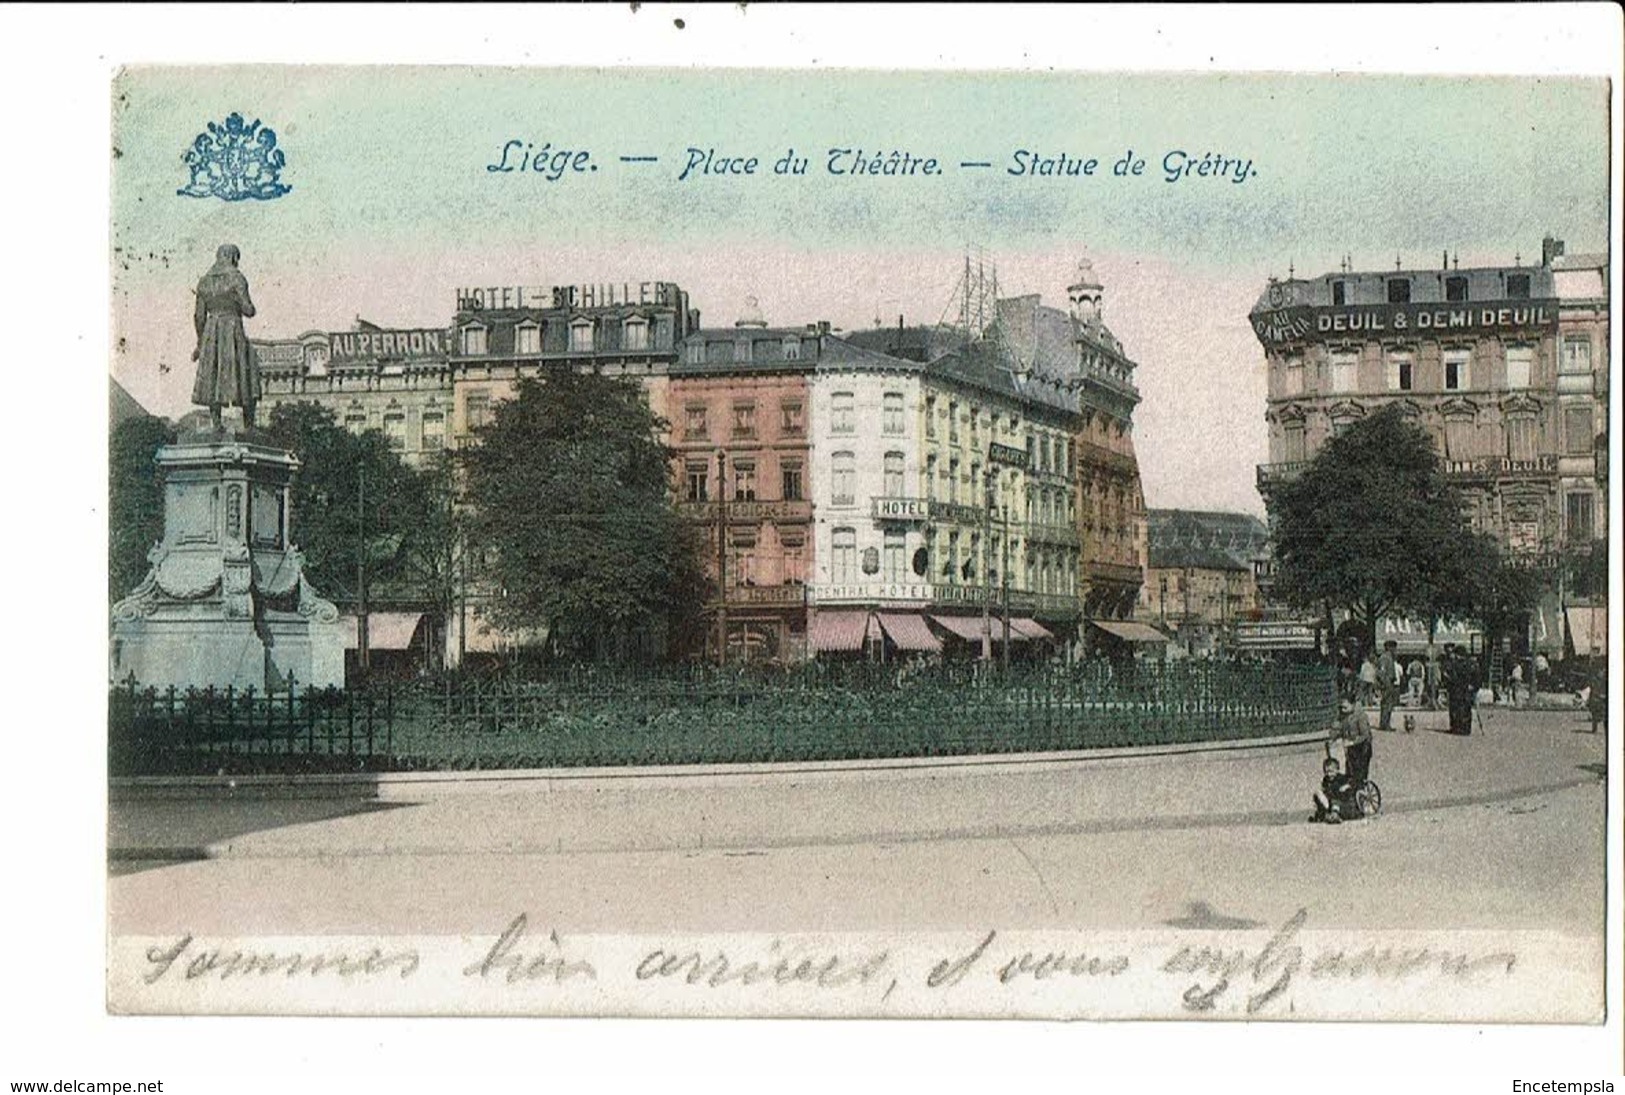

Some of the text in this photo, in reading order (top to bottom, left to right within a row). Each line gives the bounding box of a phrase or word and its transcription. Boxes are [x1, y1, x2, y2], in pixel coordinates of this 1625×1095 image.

[1274, 310, 1290, 326] AU
[1318, 307, 1551, 331] DEUIL & DEMI DEUIL
[1256, 317, 1311, 342] CAMELIA
[332, 334, 355, 356] AU
[882, 500, 925, 515] HOTEL
[816, 586, 870, 598] CENTRAL
[879, 585, 928, 598] HOTEL
[144, 932, 420, 985] Sommes
[999, 950, 1130, 985] vous
